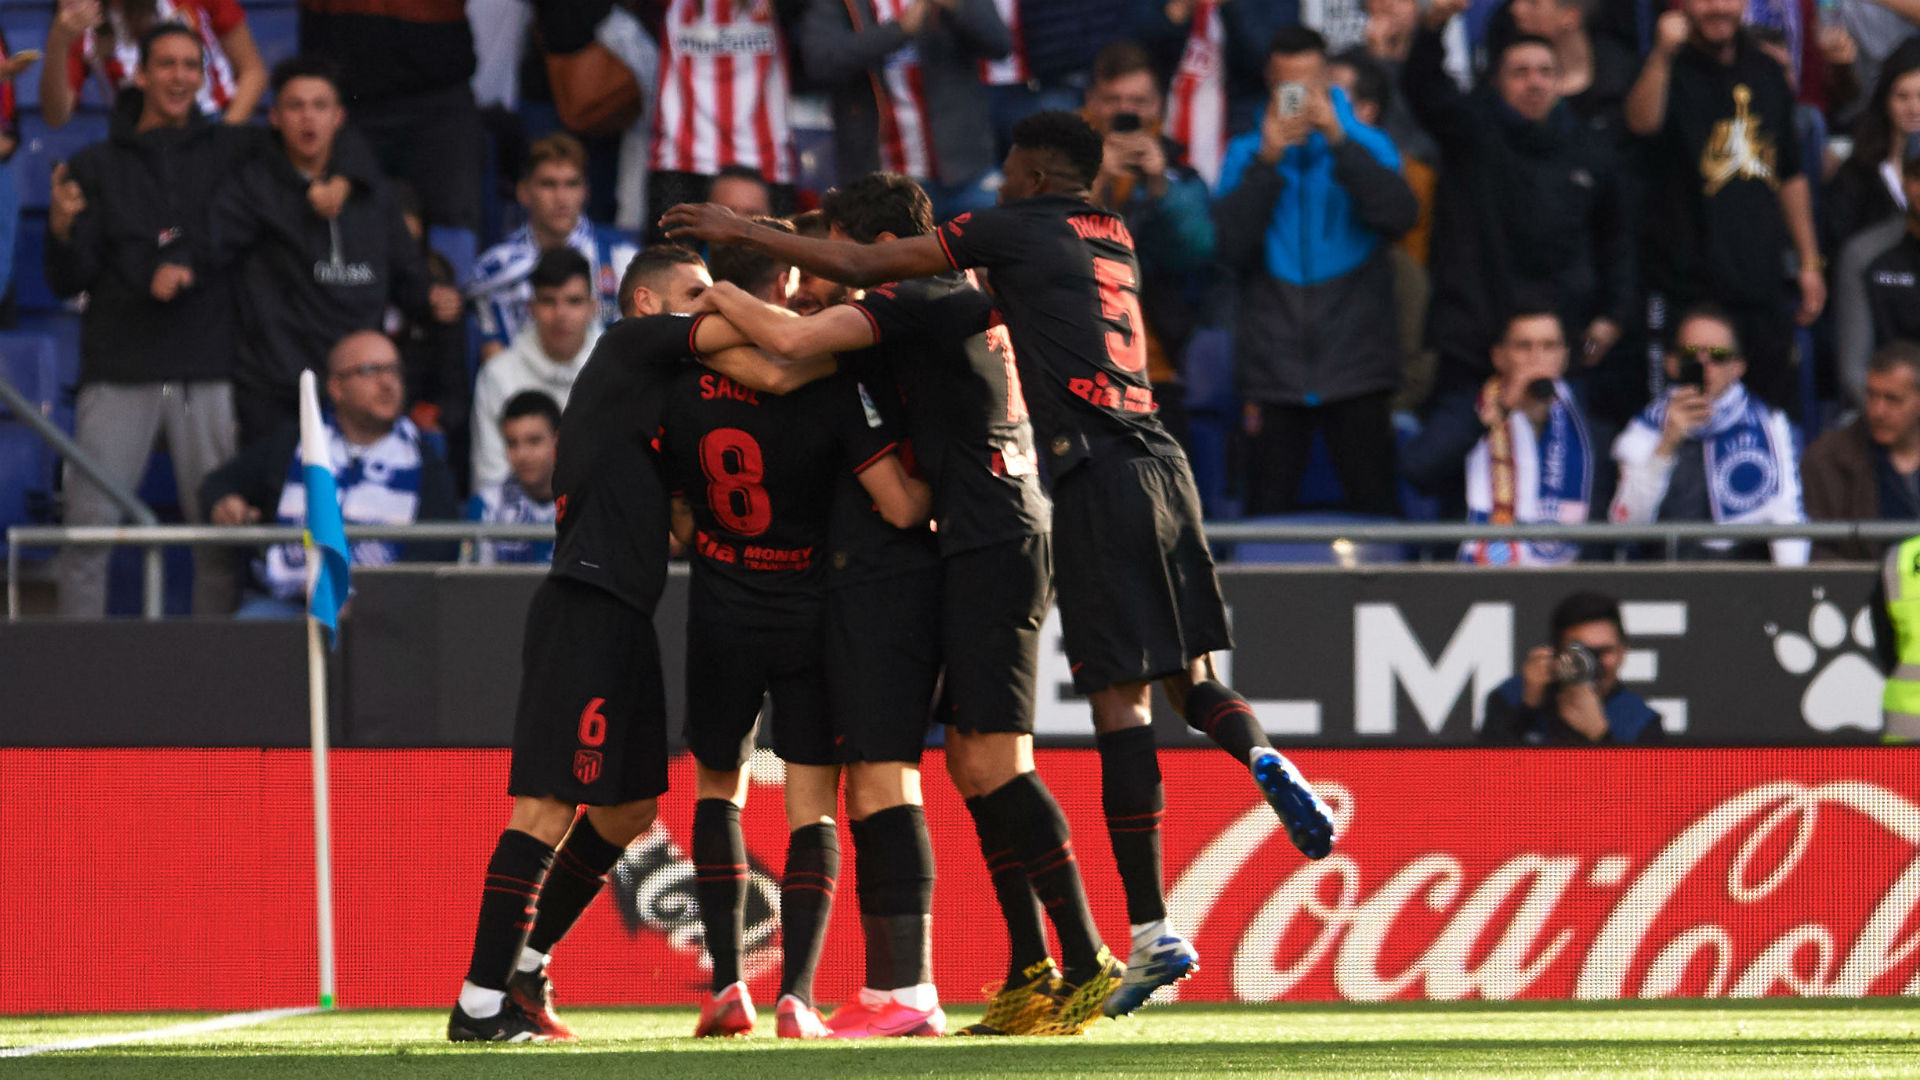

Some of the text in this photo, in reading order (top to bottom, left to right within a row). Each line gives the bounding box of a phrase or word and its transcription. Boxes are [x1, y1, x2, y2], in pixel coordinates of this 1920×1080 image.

[1092, 256, 1148, 373] 5
[699, 427, 773, 537] 8
[743, 546, 813, 562] MONEY
[577, 697, 606, 747] 6
[1147, 777, 1920, 1002] Coca-Col
